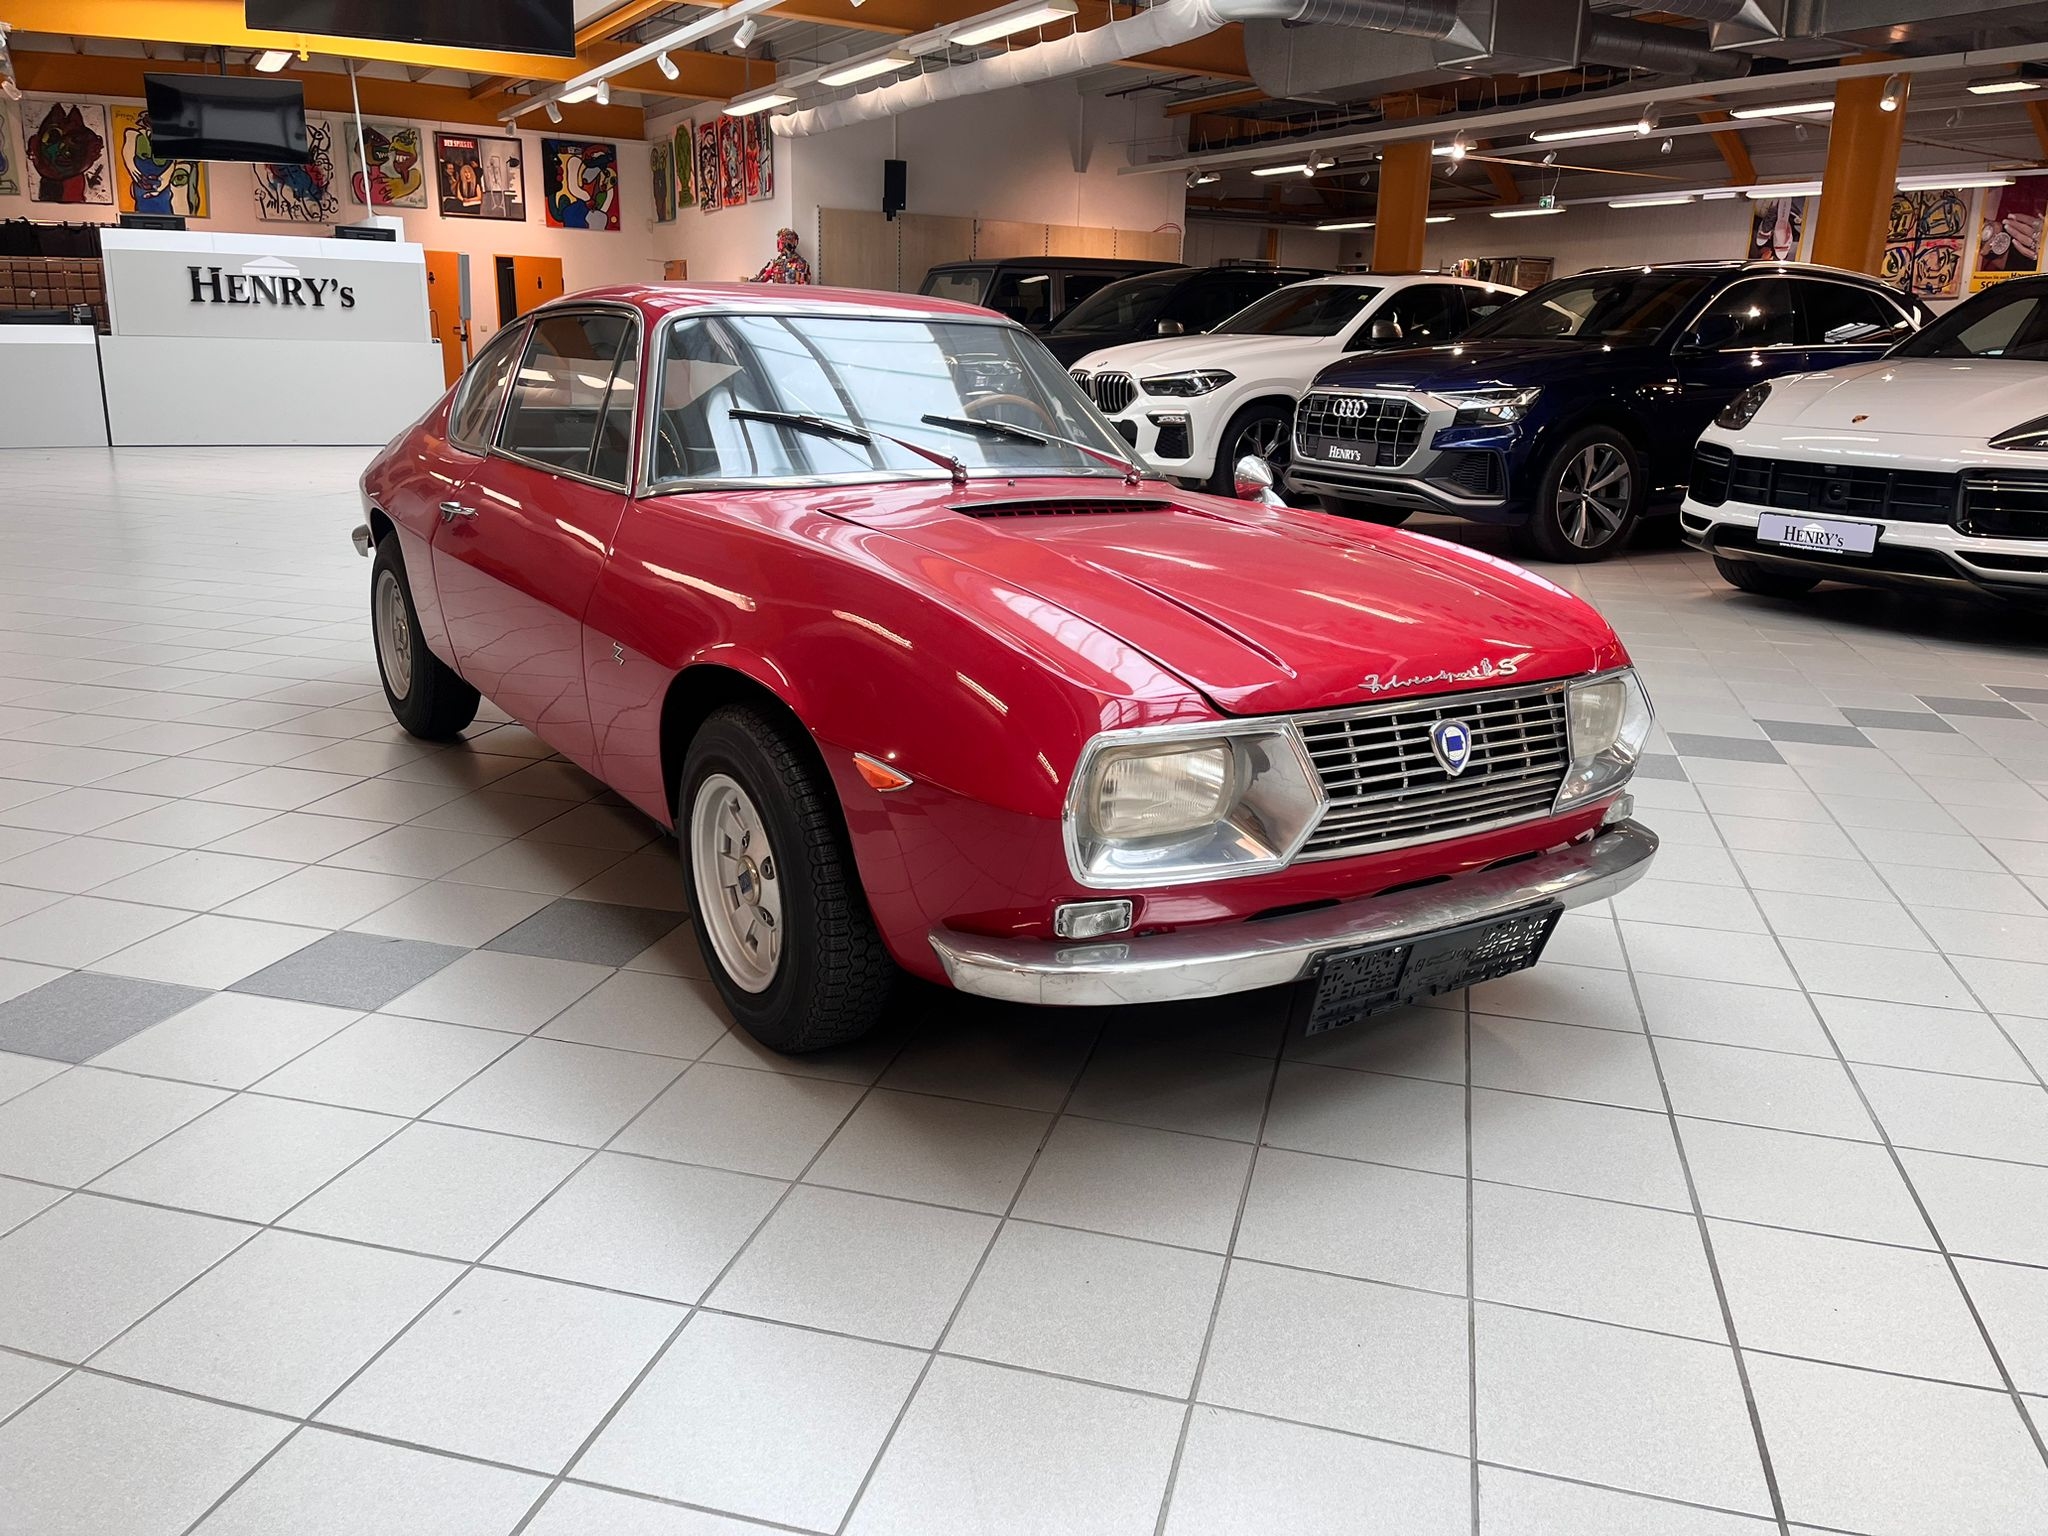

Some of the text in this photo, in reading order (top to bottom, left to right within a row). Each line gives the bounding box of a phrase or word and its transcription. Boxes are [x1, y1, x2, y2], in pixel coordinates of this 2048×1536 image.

[187, 266, 355, 308] HENRY's
[1328, 445, 1361, 461] HENRY's
[1783, 525, 1844, 547] HENRY's
